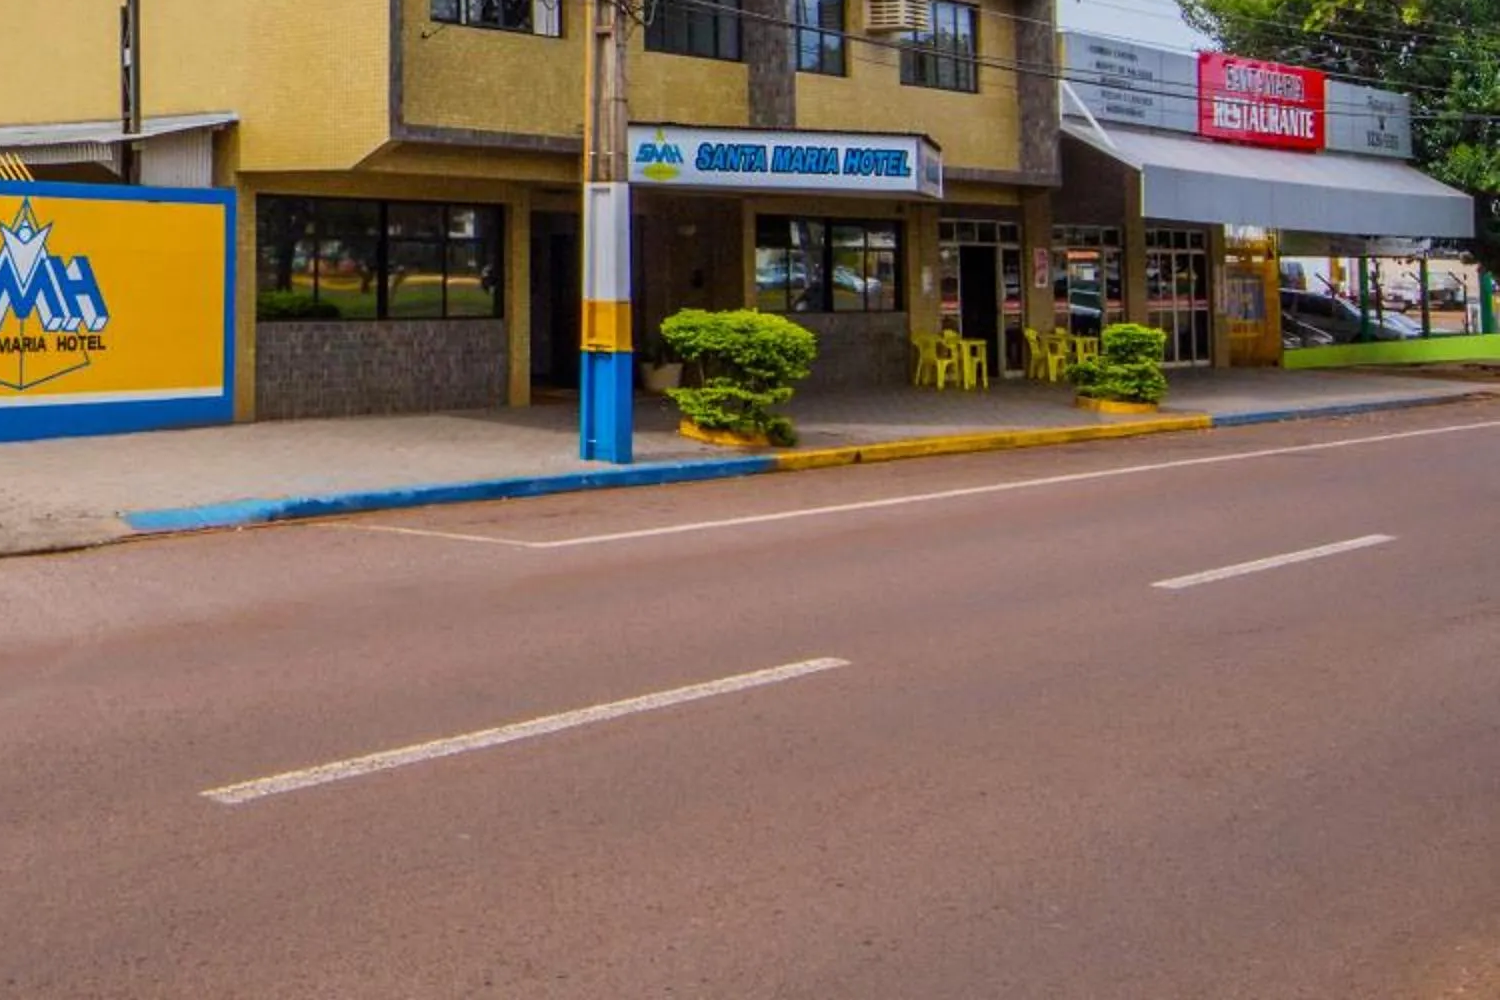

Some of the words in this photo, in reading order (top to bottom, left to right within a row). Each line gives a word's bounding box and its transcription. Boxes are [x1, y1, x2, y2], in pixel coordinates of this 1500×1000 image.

[1212, 96, 1315, 139] RESTAURANTE
[695, 142, 768, 172] SANTA
[771, 145, 839, 174] MARIA
[843, 148, 911, 177] HOTEL
[57, 334, 106, 352] HOTEL
